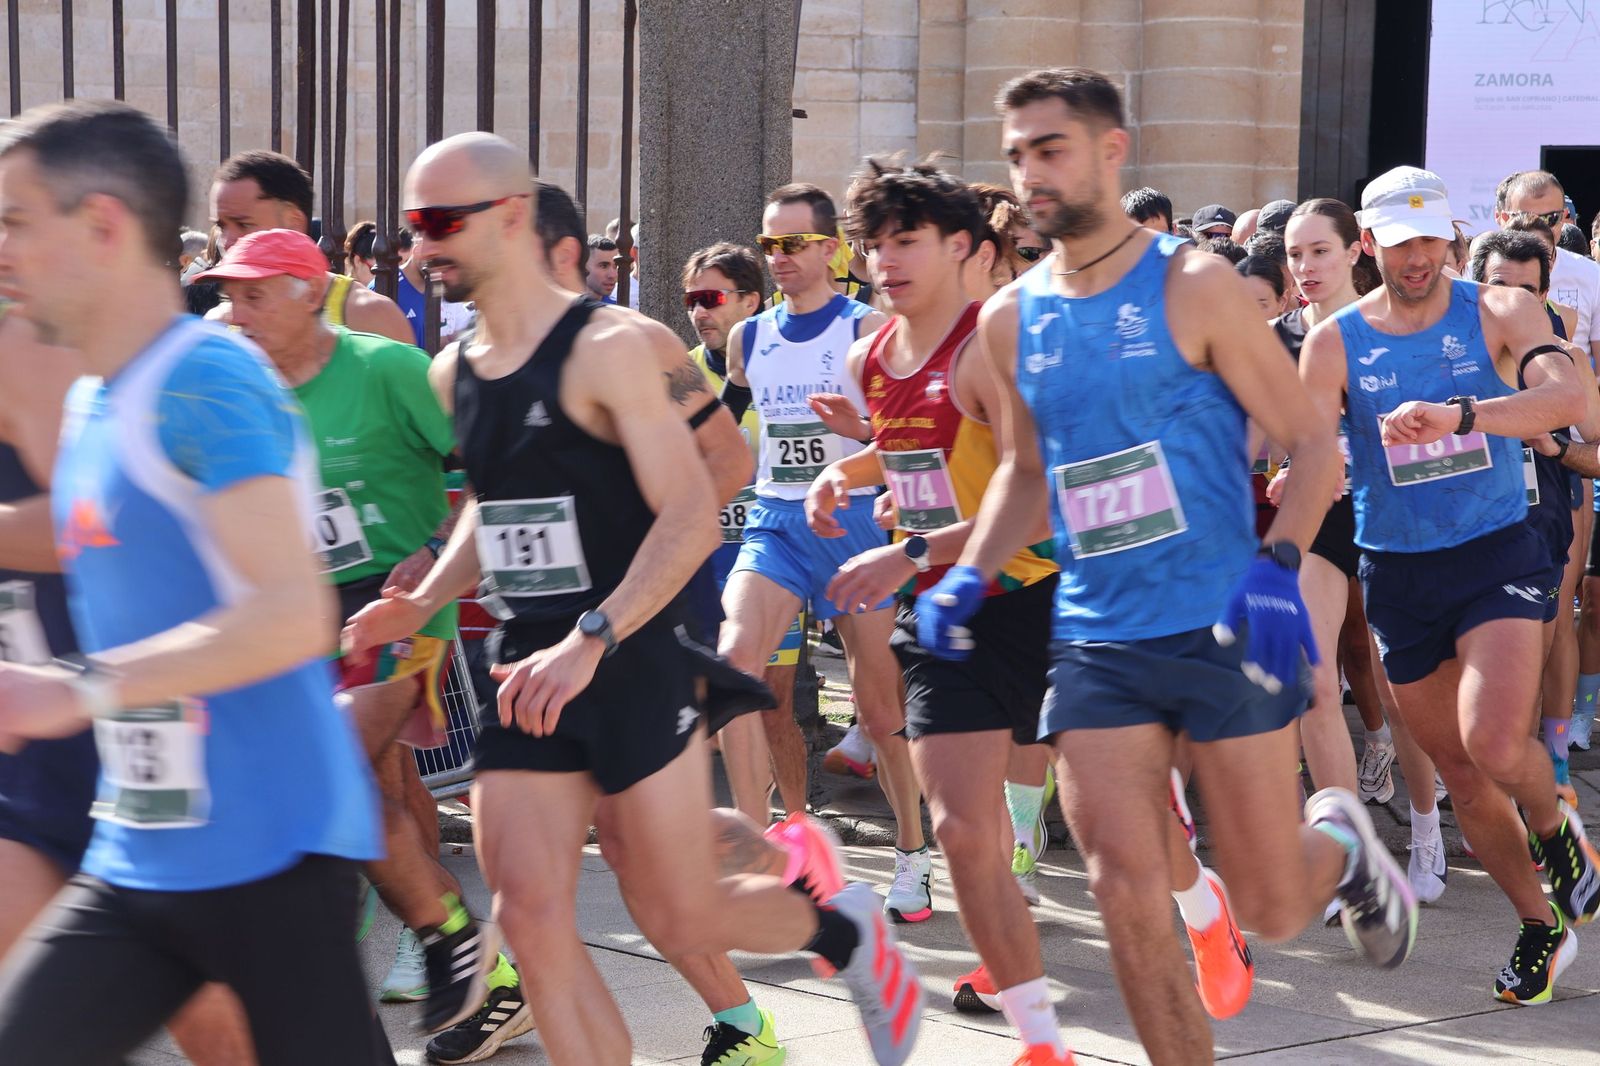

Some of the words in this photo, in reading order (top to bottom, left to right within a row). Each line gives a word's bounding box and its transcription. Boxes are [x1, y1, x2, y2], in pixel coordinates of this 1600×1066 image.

[1474, 73, 1554, 87] ZAMORA
[779, 438, 825, 464] 256
[1076, 475, 1144, 526] 727
[718, 504, 746, 526] 58
[496, 526, 553, 566] 191
